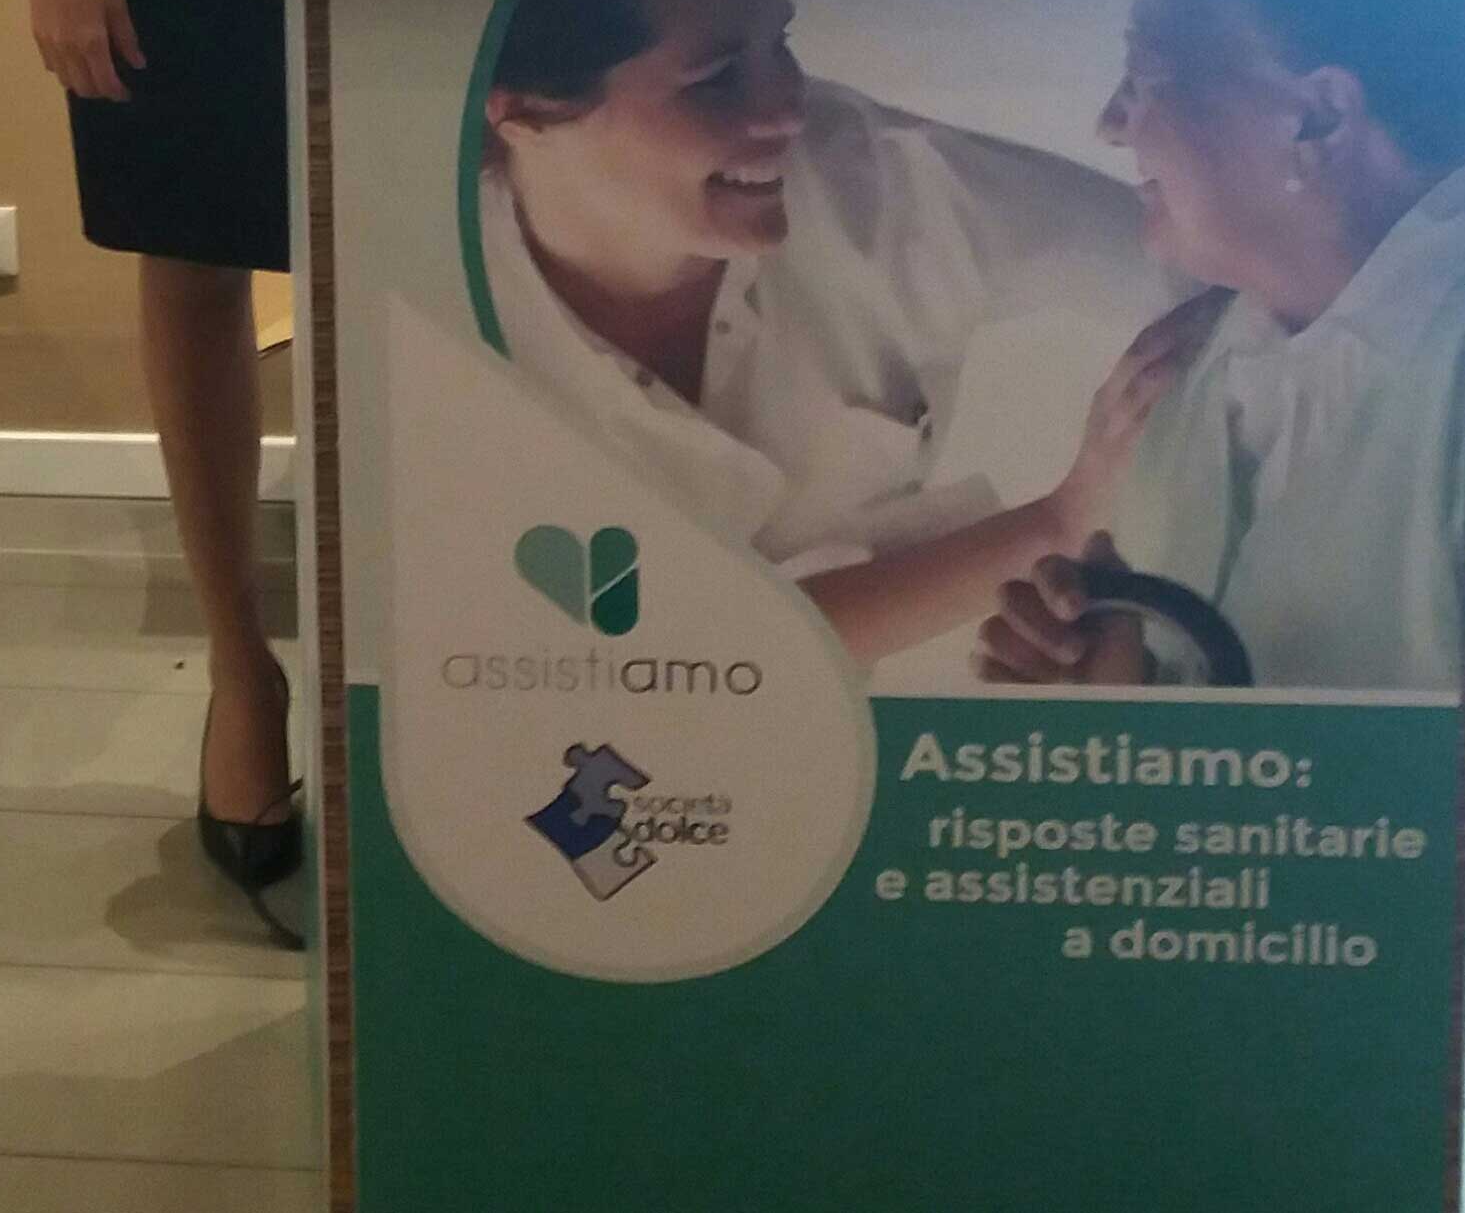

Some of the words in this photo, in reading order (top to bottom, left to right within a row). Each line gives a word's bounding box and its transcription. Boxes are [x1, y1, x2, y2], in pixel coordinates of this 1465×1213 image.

[442, 648, 763, 695] assistiamo
[900, 732, 1313, 788] Assistiamo:
[633, 816, 730, 845] dolce
[928, 807, 1158, 859] risposte
[1174, 814, 1427, 860] sanitarie
[874, 868, 908, 900] e
[924, 863, 1272, 909] assistenziali
[1060, 925, 1094, 959] a
[1108, 919, 1378, 967] domicilio
